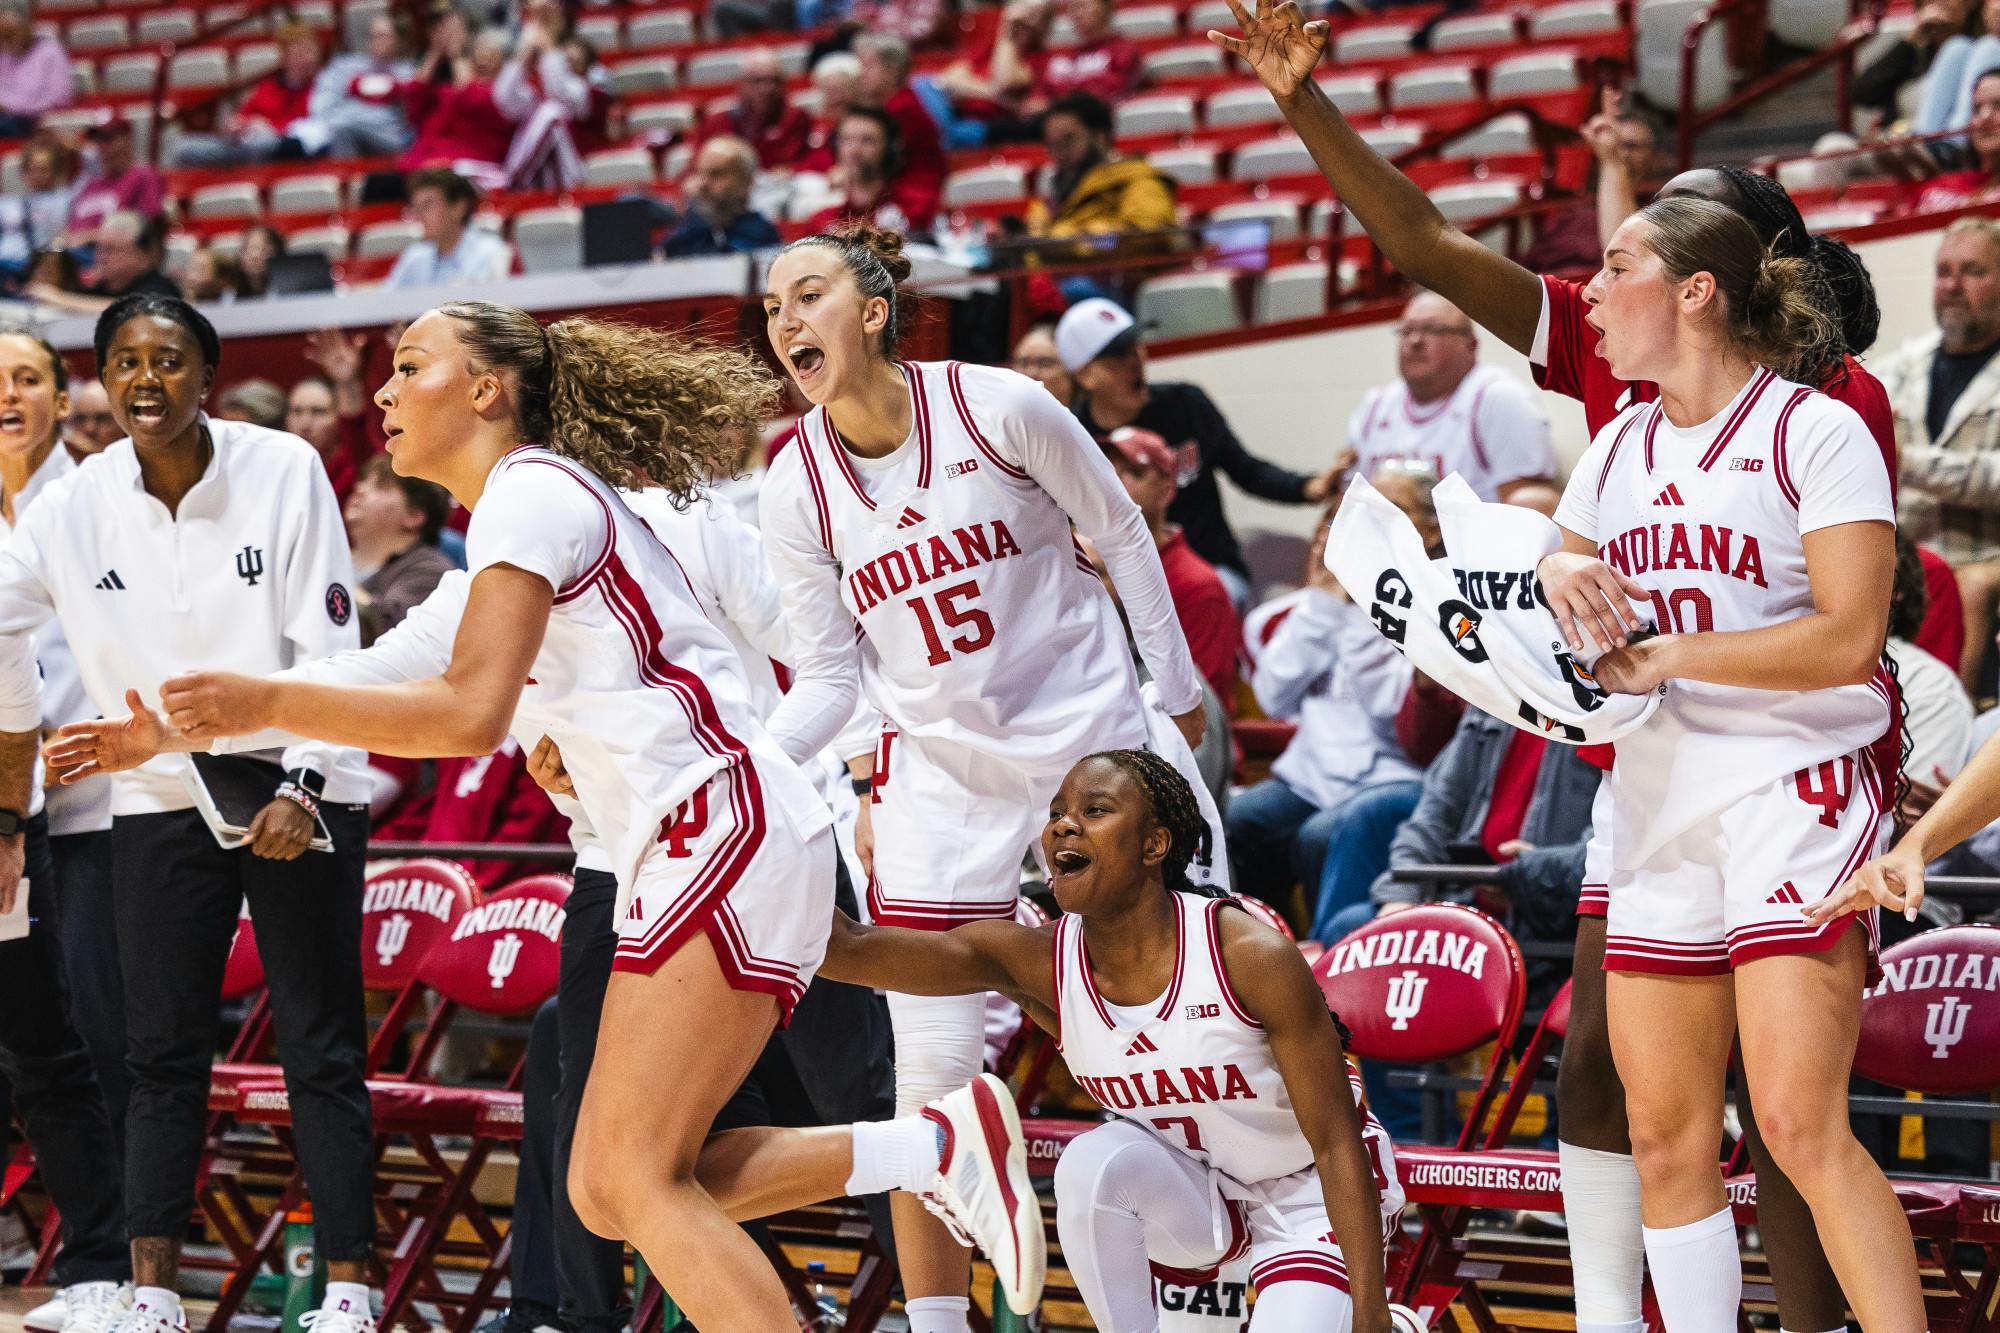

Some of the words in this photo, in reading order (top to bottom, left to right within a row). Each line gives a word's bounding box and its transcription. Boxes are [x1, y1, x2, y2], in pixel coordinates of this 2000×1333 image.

[849, 519, 1022, 615] INDIANA
[905, 579, 996, 667] 15
[1371, 568, 1413, 655] GA
[362, 878, 456, 924] DIANA
[451, 897, 567, 943] INDIANA
[1326, 929, 1488, 981] INDIANA
[1863, 953, 2000, 999] NDIA
[1076, 1063, 1257, 1110] INDIANA
[1150, 1115, 1209, 1153] 7
